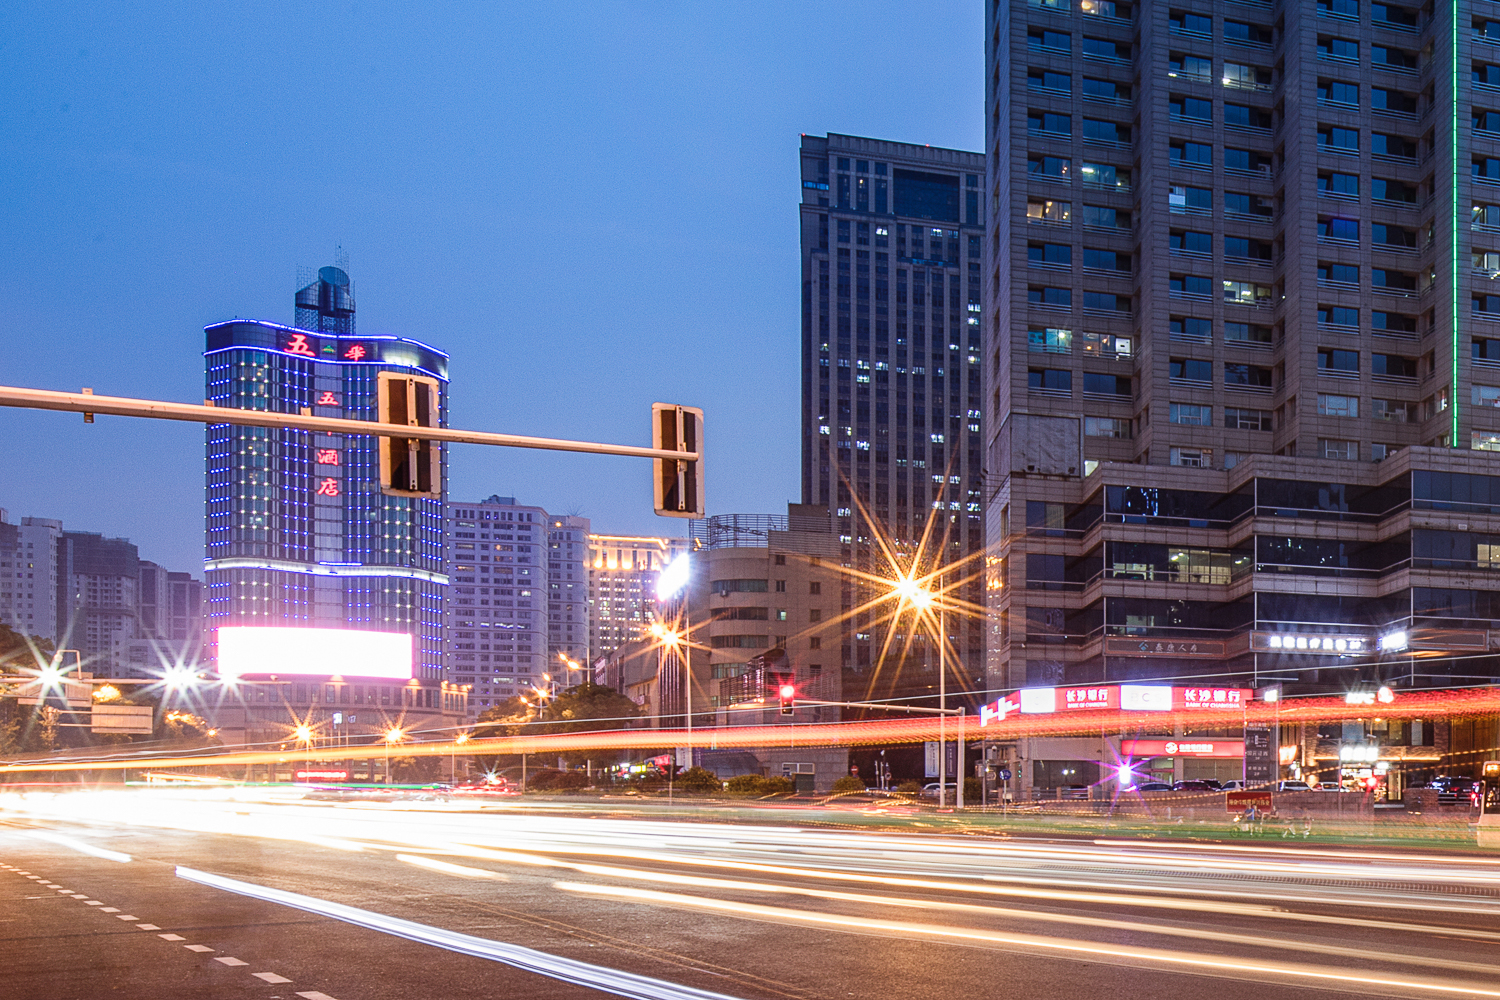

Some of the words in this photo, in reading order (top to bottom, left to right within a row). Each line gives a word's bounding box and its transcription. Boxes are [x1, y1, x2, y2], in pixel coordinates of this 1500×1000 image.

[283, 333, 316, 357] 五
[317, 391, 339, 497] 五酒店
[1066, 688, 1109, 702] 长沙银行
[1184, 689, 1241, 702] 长沙银行
